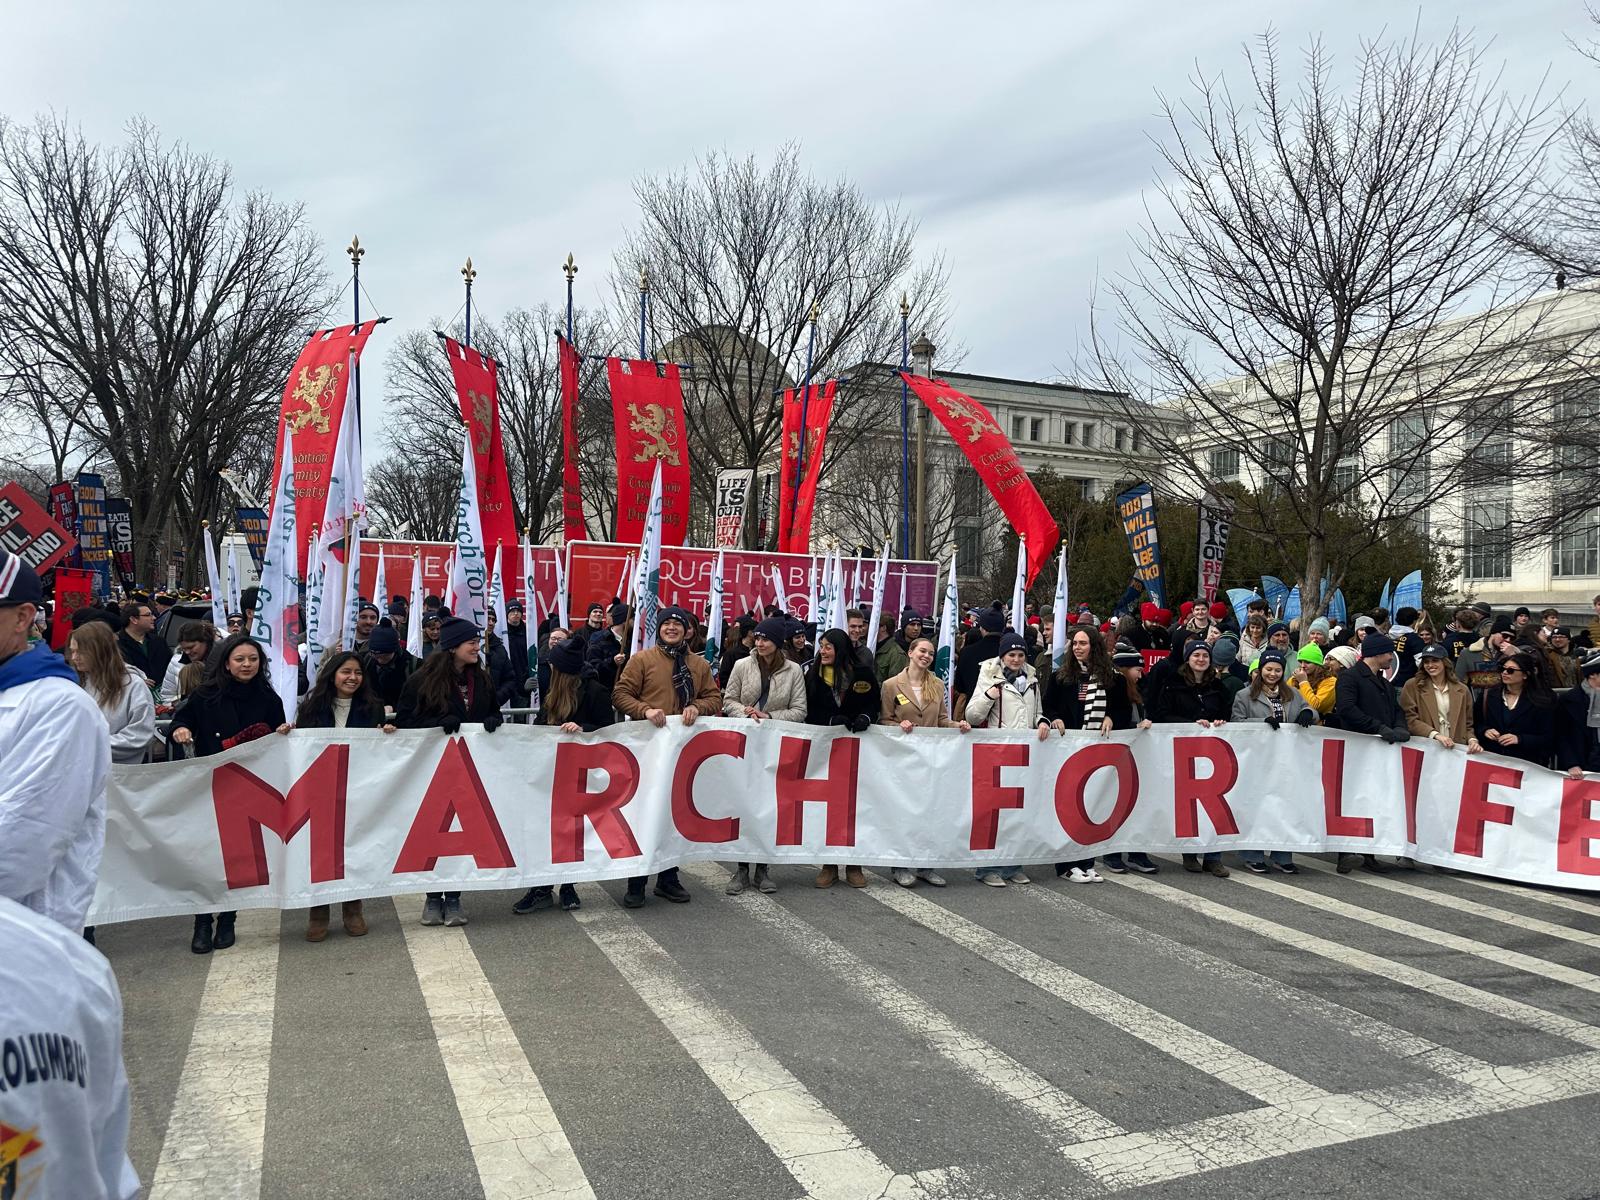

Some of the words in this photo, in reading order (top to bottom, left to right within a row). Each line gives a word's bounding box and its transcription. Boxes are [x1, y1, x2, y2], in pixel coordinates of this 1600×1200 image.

[719, 478, 747, 489] LIFE
[719, 489, 745, 506] IS
[717, 506, 743, 517] OUR
[18, 531, 62, 569] TAND
[212, 730, 860, 889] MARCH
[969, 737, 1240, 851] FOR
[1321, 738, 1600, 876] LIFE
